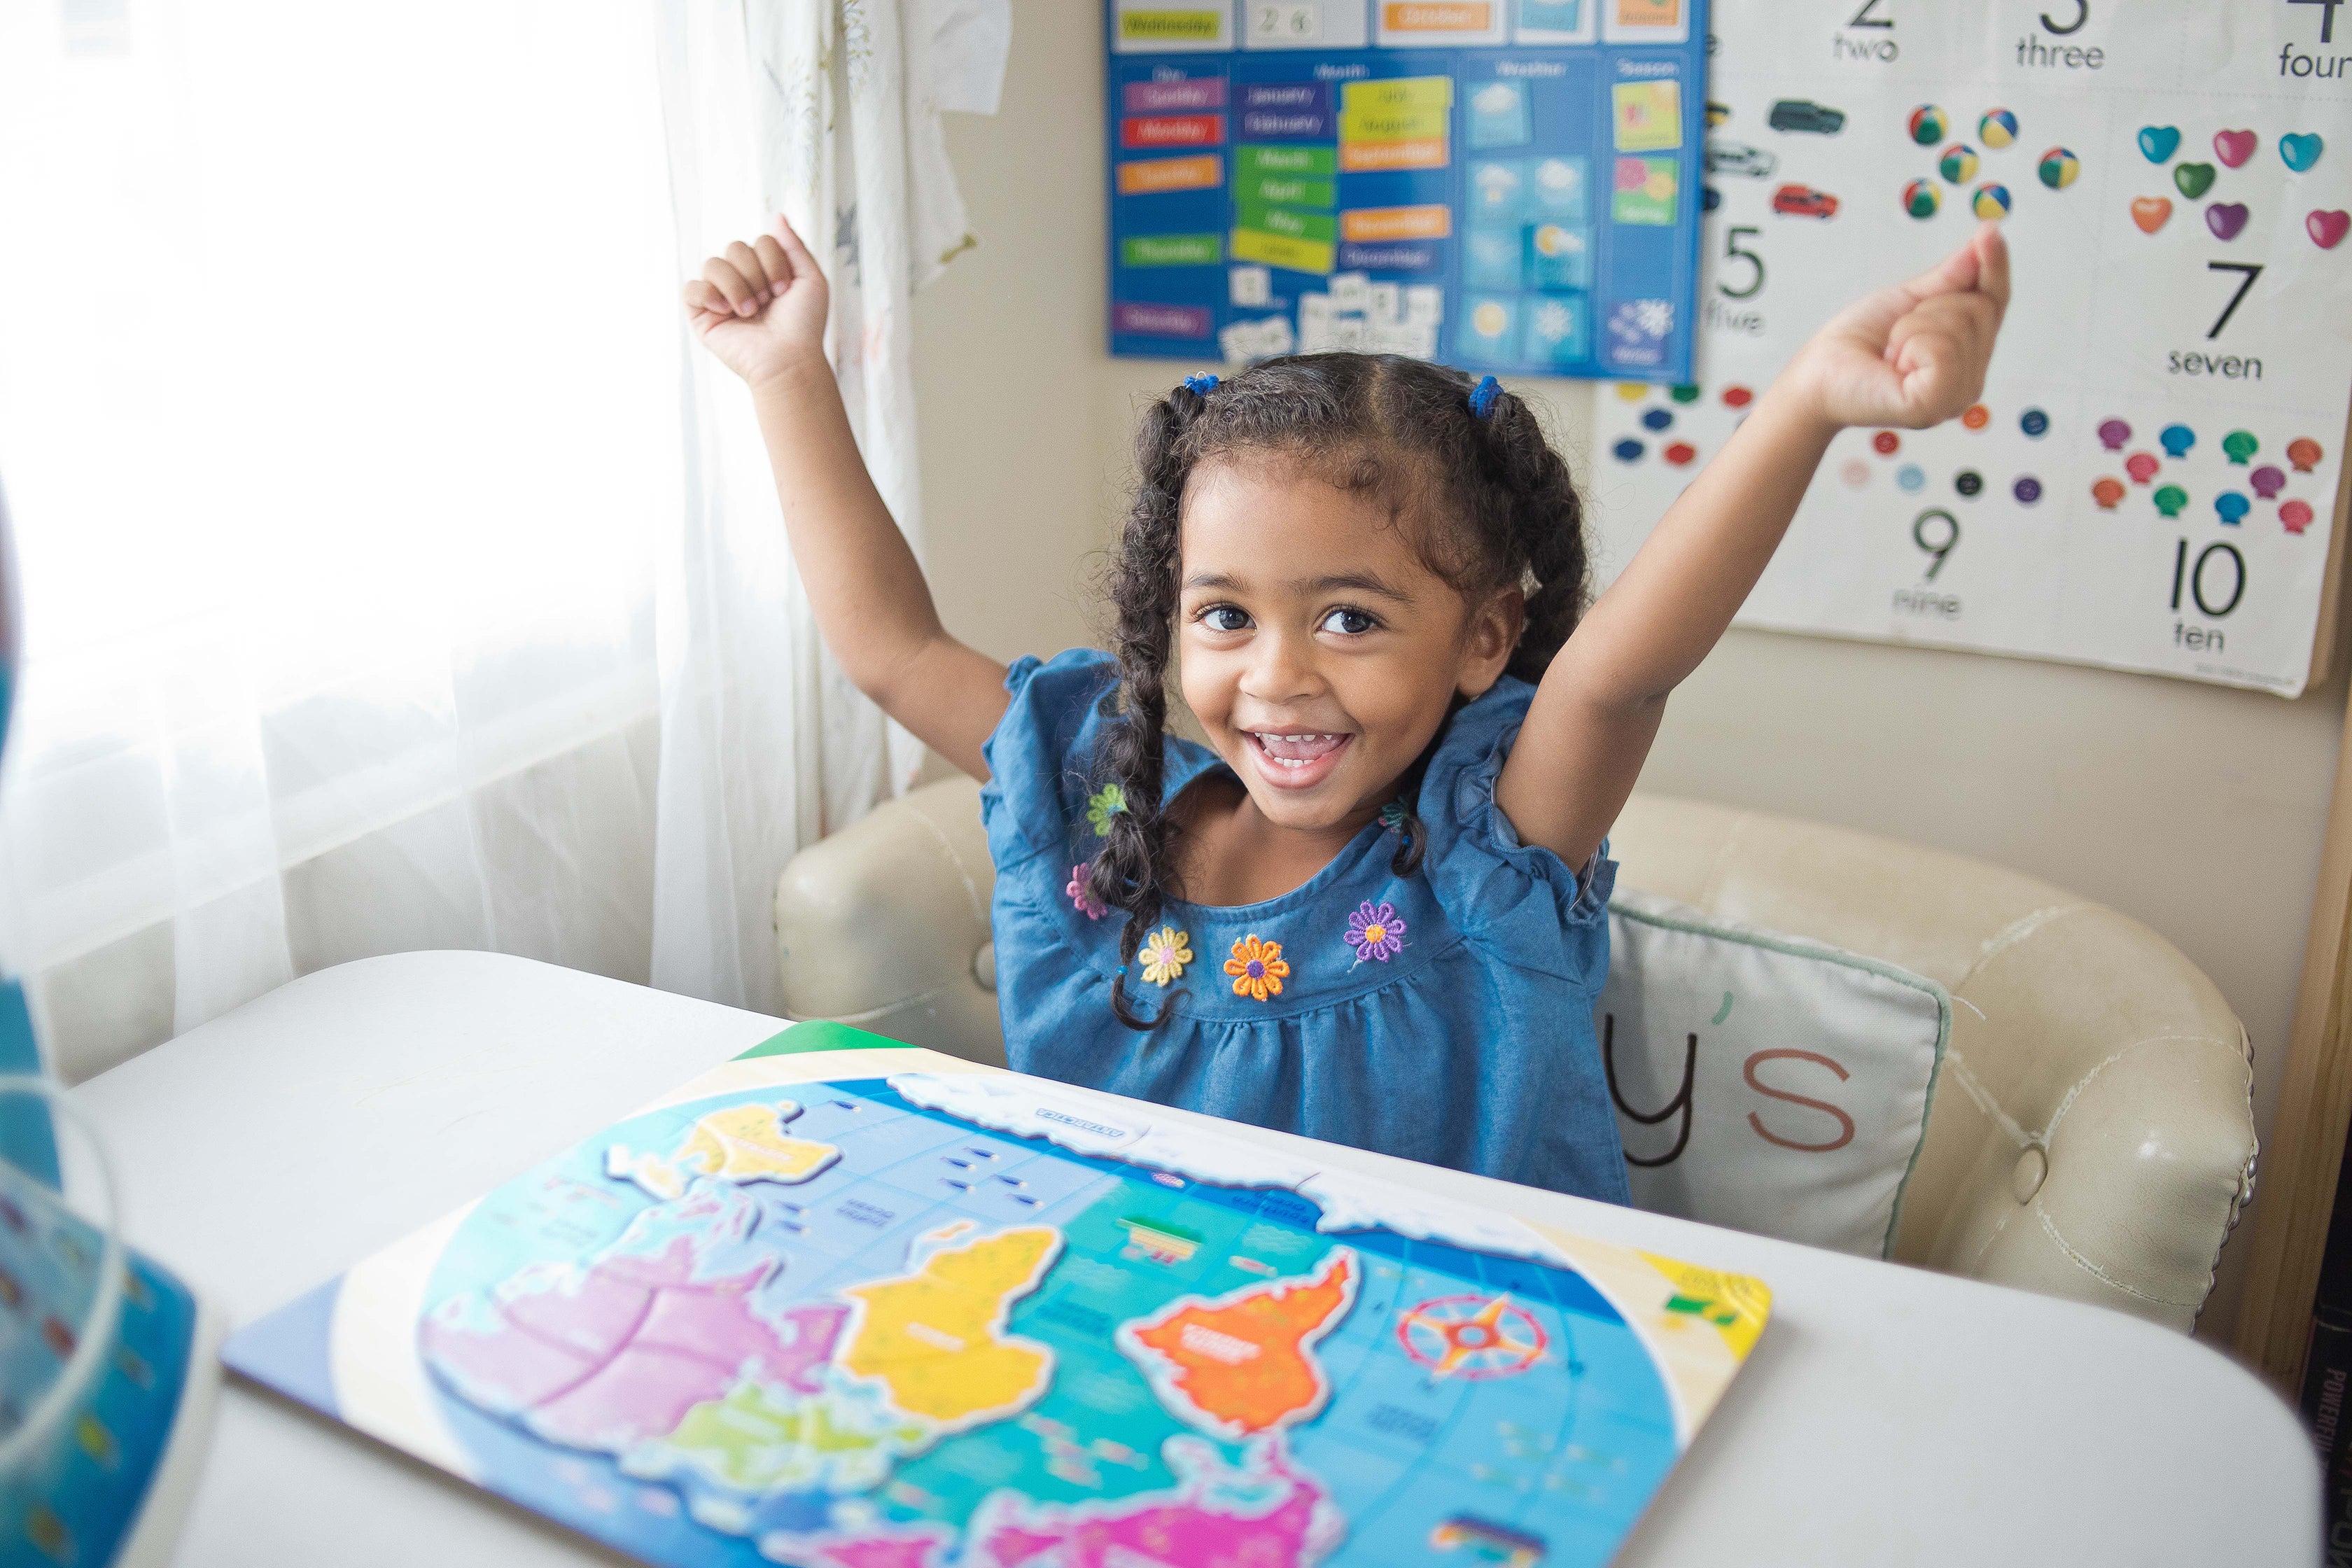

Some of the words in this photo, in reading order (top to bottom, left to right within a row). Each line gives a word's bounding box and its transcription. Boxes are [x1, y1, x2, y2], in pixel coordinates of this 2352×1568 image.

[1833, 32, 1899, 62] two
[2017, 33, 2105, 69] three
[2279, 43, 2352, 78] four
[1719, 225, 1765, 299] 5
[1704, 299, 1765, 336] five
[2207, 260, 2266, 341] 7
[2168, 349, 2262, 380] seven
[1913, 510, 1960, 580] 9
[2171, 538, 2247, 617] 10
[1891, 589, 1961, 622] nine
[2174, 619, 2225, 652] ten
[1036, 1108, 1124, 1137] ANTARCTICA
